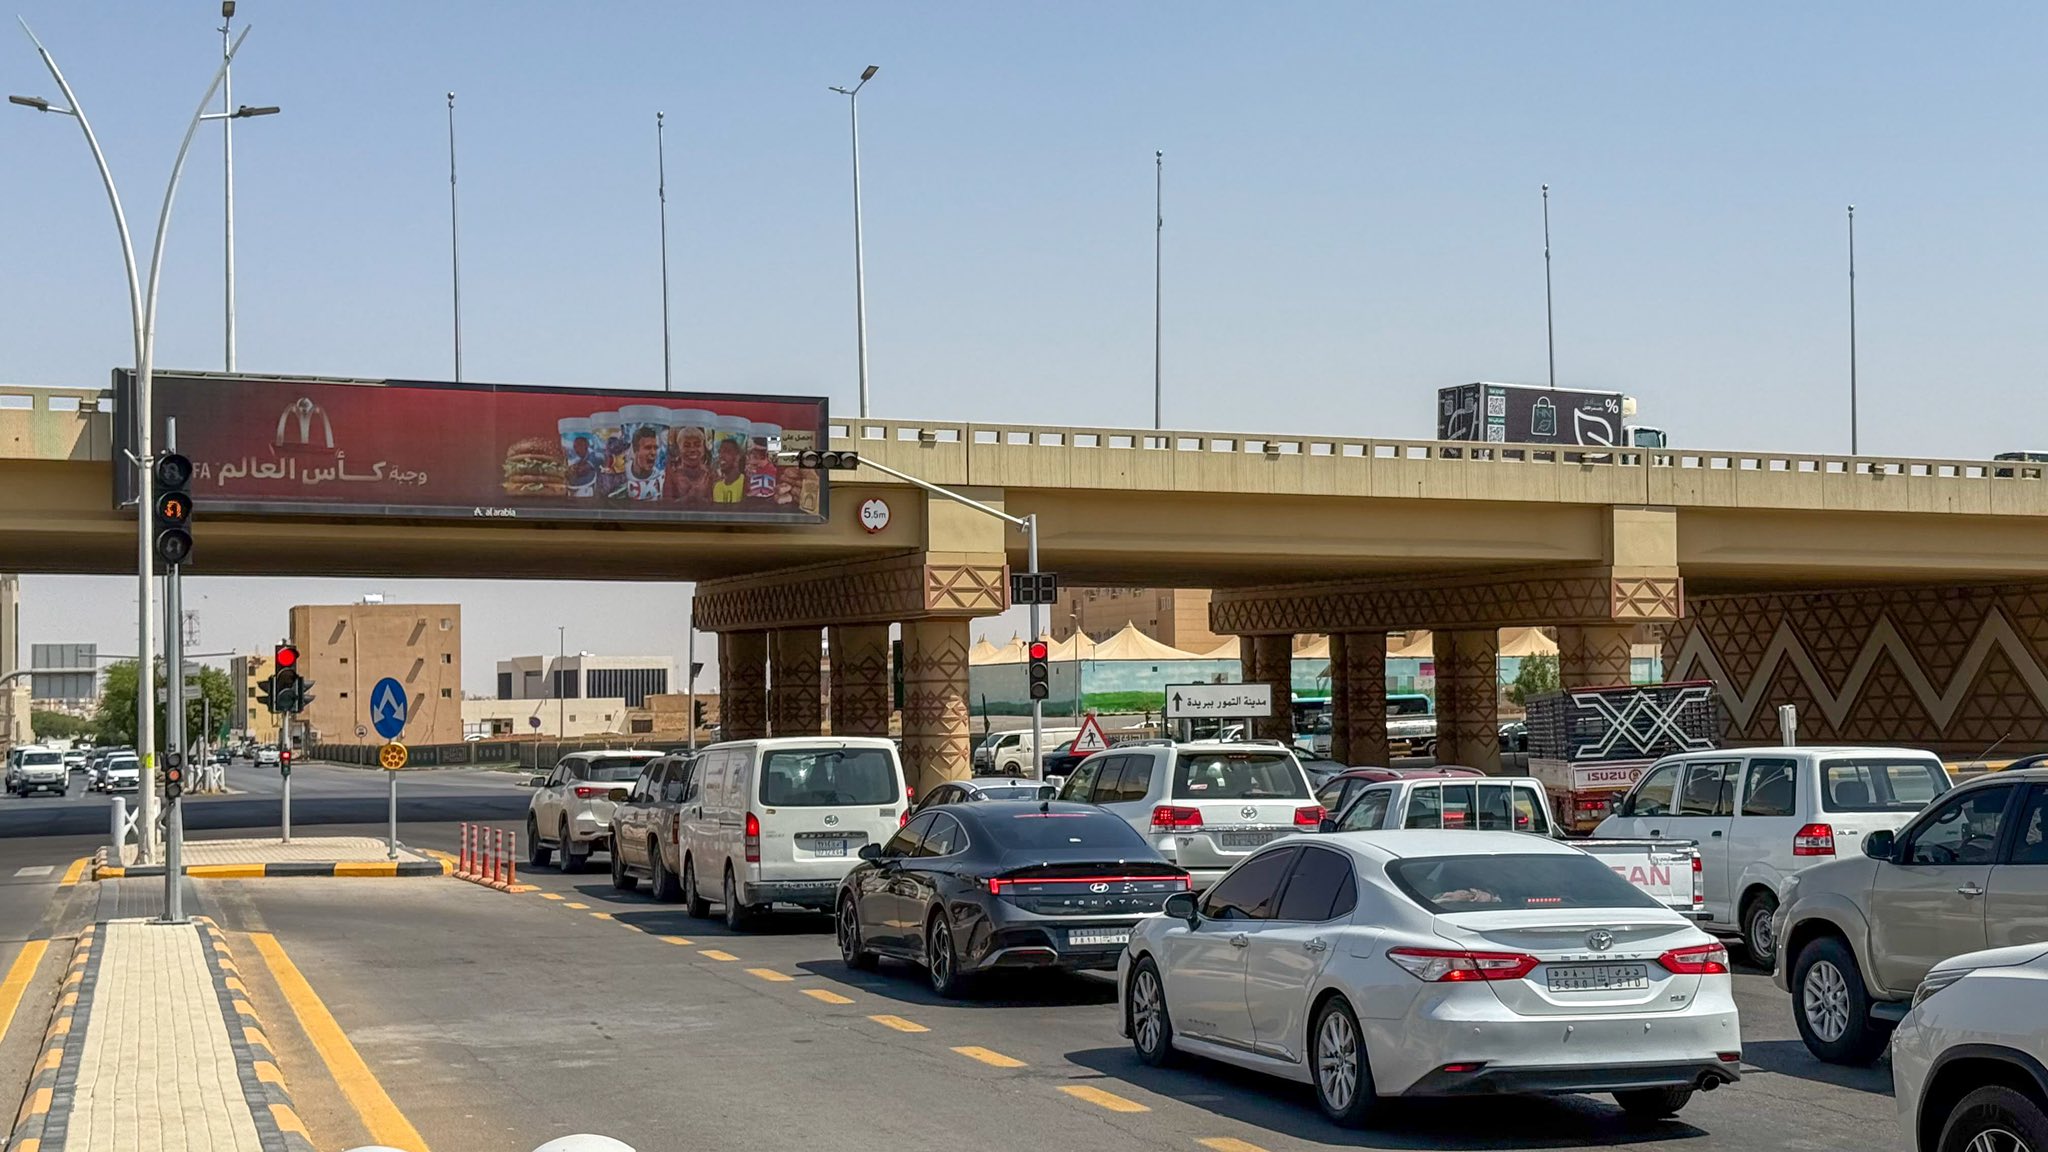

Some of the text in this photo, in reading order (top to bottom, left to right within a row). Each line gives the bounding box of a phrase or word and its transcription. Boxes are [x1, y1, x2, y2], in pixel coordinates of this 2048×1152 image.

[218, 450, 428, 486] وجبة كأس العالم
[1187, 696, 1267, 709] مدينة التمور ببريدة
[1587, 771, 1626, 782] ISUZU
[1555, 980, 1588, 990] 5580
